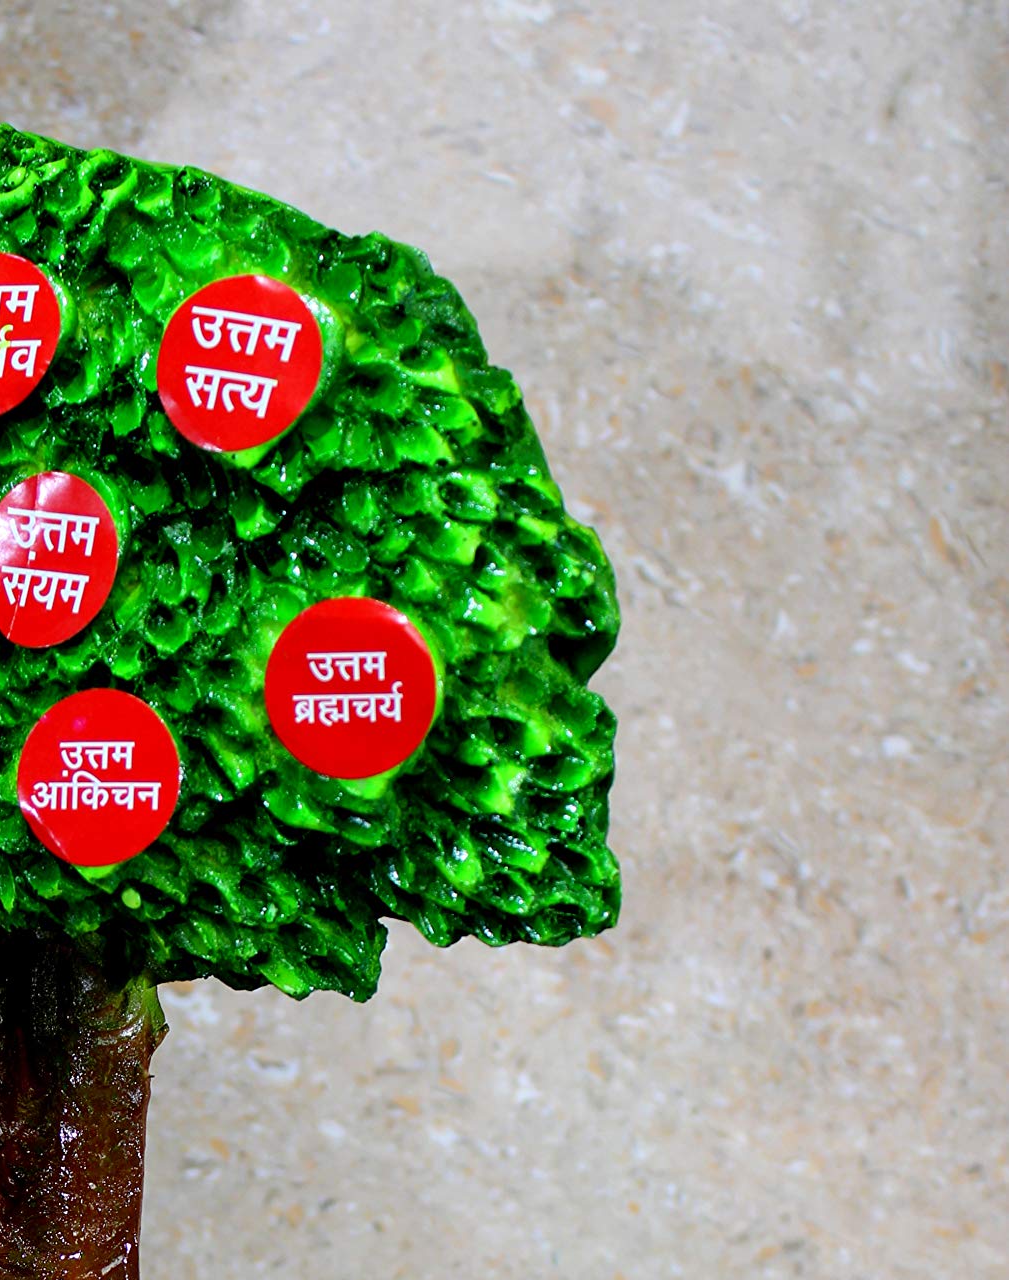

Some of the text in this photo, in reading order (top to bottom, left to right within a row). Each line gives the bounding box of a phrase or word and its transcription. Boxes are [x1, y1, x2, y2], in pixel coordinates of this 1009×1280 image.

[191, 306, 301, 362] उत्तम
[185, 365, 277, 418] सत्य
[8, 507, 100, 556] उत्तम
[1, 551, 89, 613] संयम
[307, 651, 386, 682] उत्तम
[293, 682, 403, 726] ब्रह्मचर्य
[60, 742, 135, 770] उत्तम
